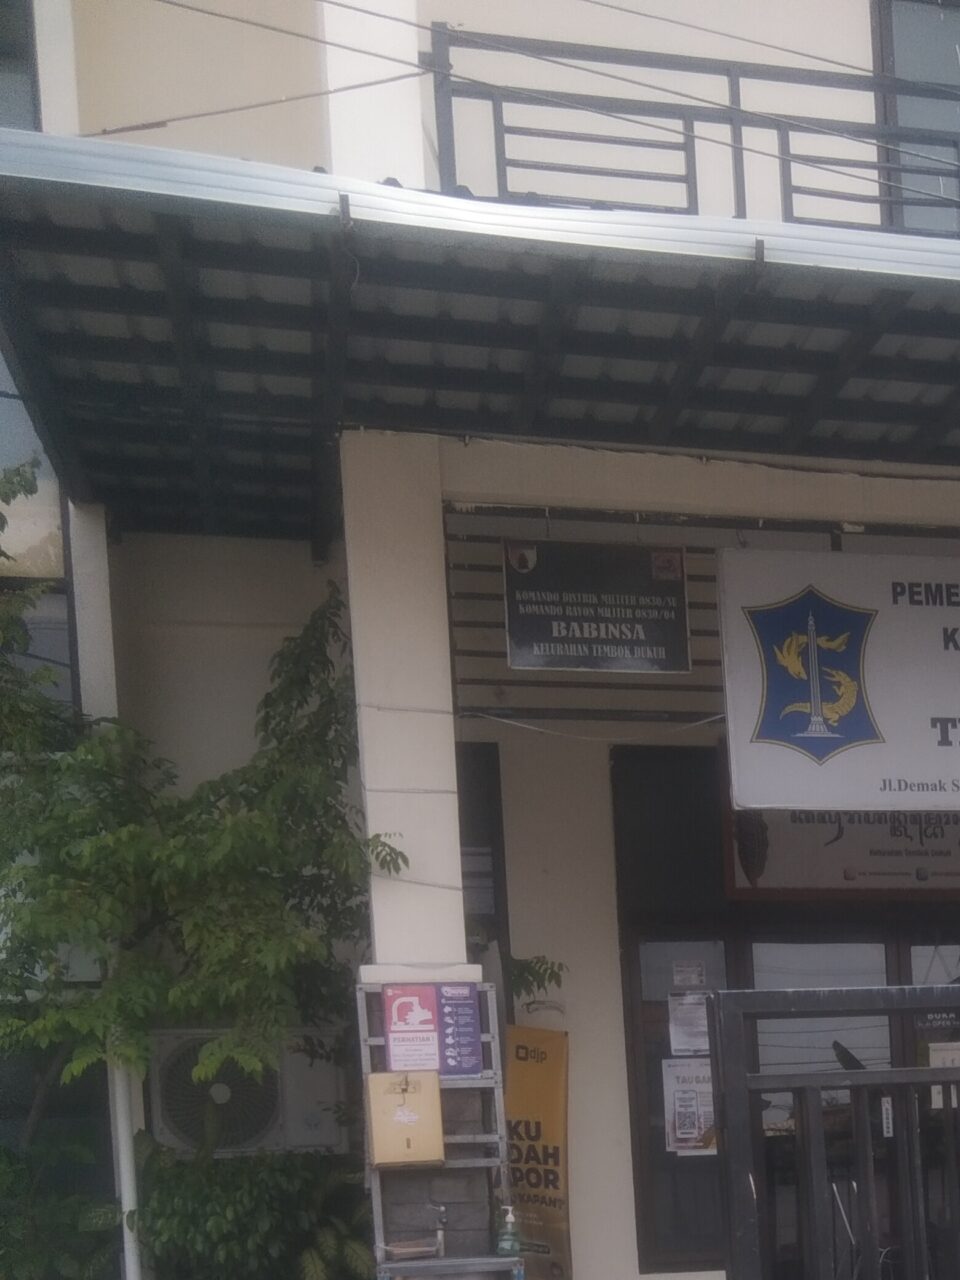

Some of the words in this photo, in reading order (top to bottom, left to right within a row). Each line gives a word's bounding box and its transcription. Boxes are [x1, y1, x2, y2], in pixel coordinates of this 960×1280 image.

[515, 590, 560, 602] KOMANDO
[562, 592, 598, 604] DISTRIK
[518, 604, 563, 616] KOMANDO
[565, 606, 595, 617] RAYON
[551, 621, 646, 641] BABINSA
[533, 642, 589, 657] KELURAHAN
[592, 644, 632, 659] TEMBOK
[633, 646, 666, 659] DUKUH
[879, 777, 948, 794] Jl.Demak
[529, 1046, 548, 1064] djp
